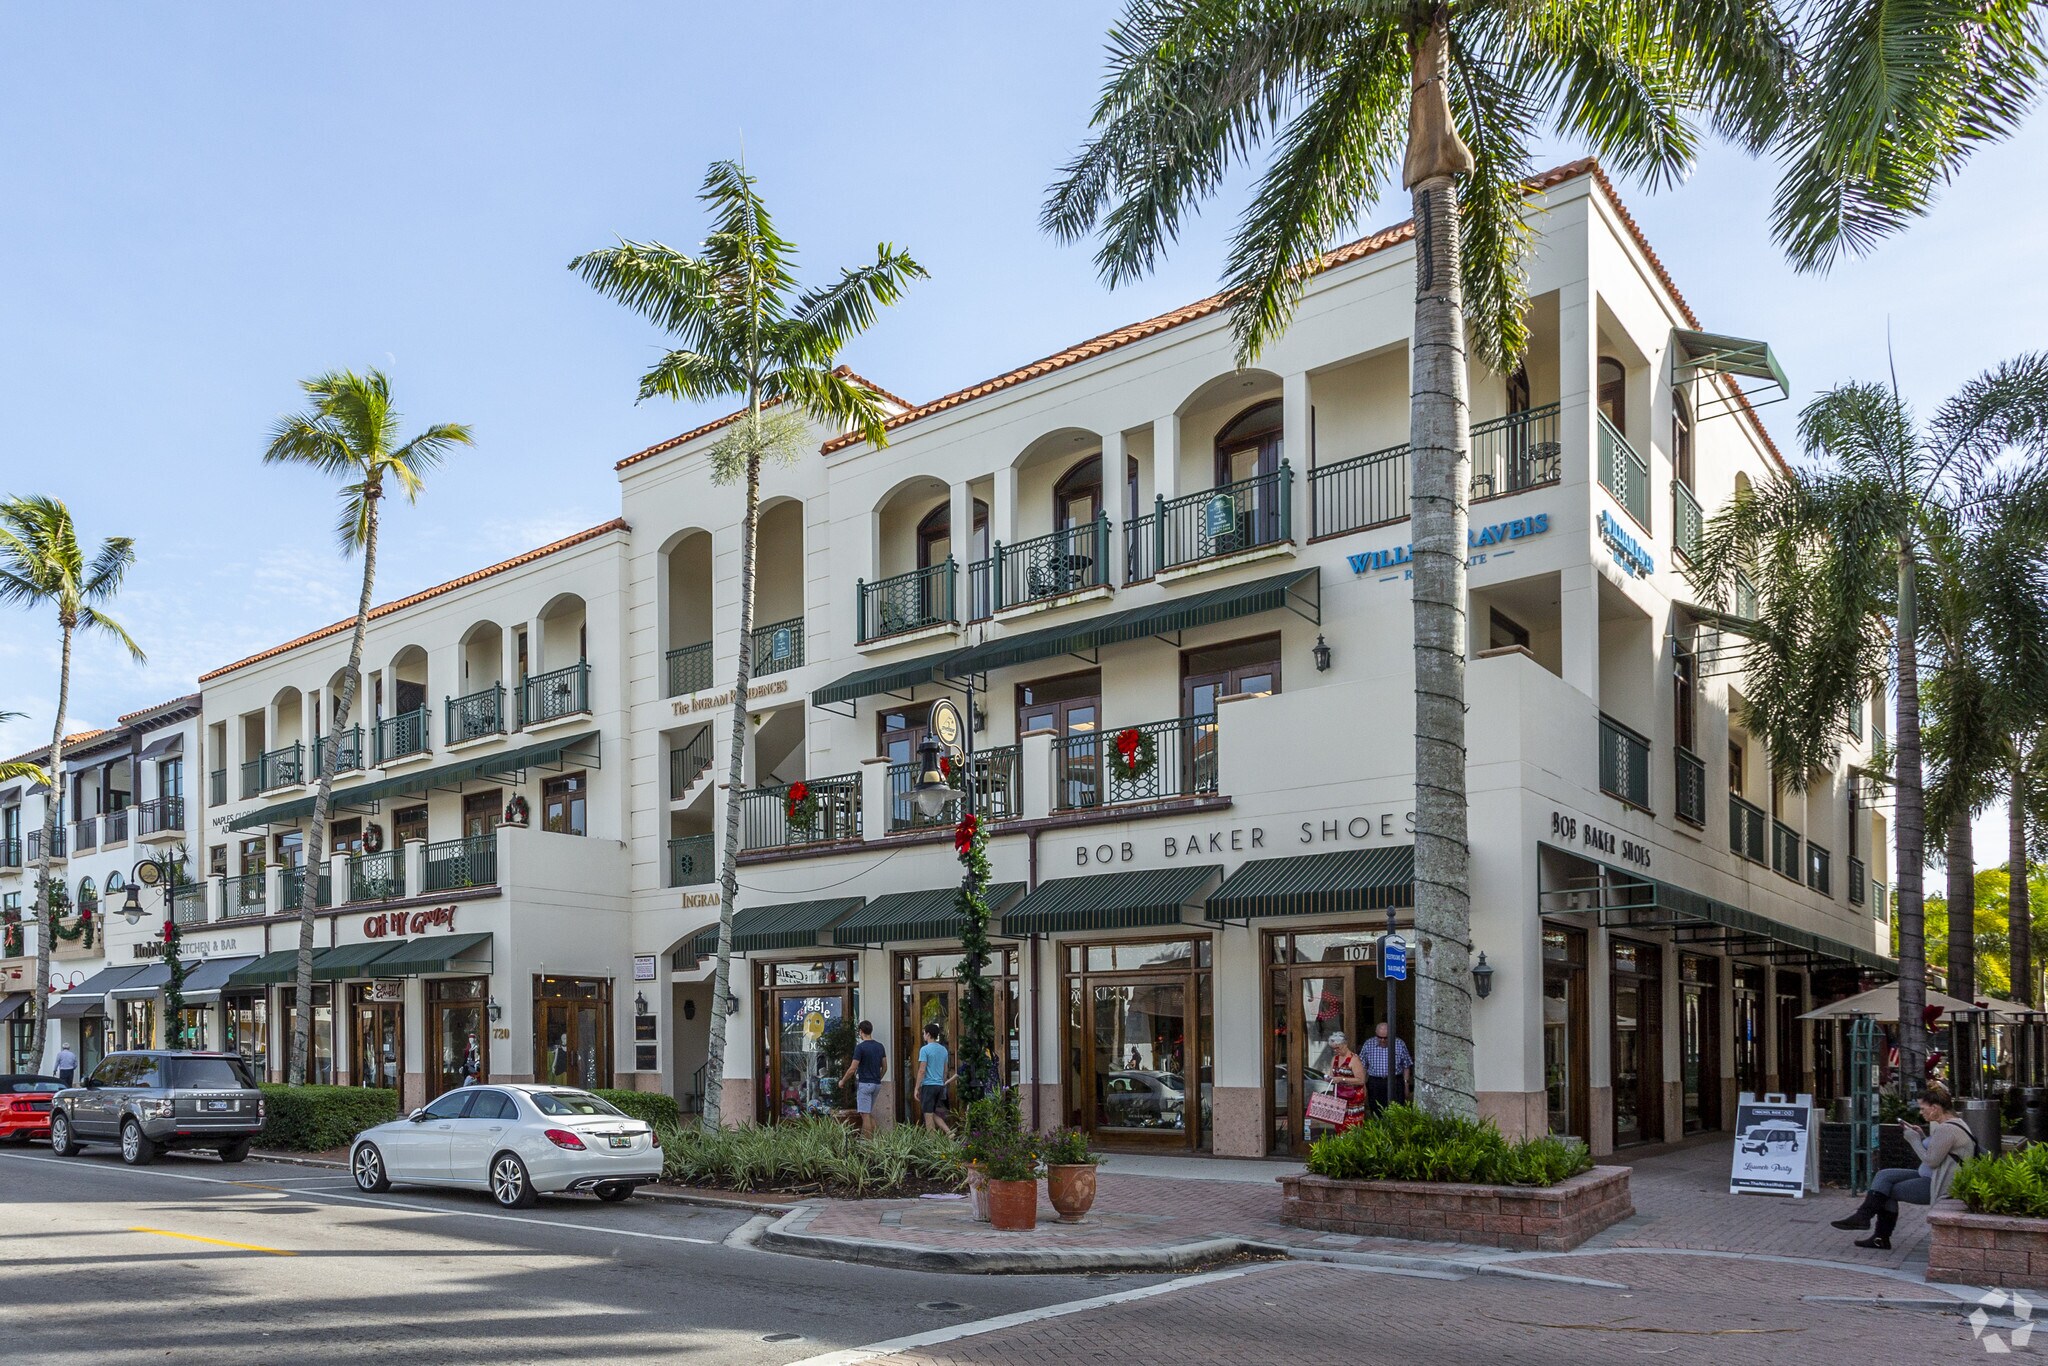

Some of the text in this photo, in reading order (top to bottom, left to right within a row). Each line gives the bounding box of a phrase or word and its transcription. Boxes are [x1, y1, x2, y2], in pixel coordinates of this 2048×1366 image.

[1346, 544, 1413, 574] WILLI
[671, 701, 690, 716] The
[729, 680, 788, 704] RIDENCES
[212, 814, 234, 827] NAPLES
[1076, 811, 1416, 866] BOB BAKER SHOES
[1553, 811, 1651, 867] BOB BAKER SHOES
[364, 913, 388, 938] OH
[390, 911, 410, 936] MY
[213, 941, 218, 951] &
[221, 938, 237, 951] BAR
[1346, 947, 1368, 960] 107
[796, 998, 831, 1020] giggle
[493, 1028, 510, 1040] 720
[1771, 1163, 1792, 1175] Party
